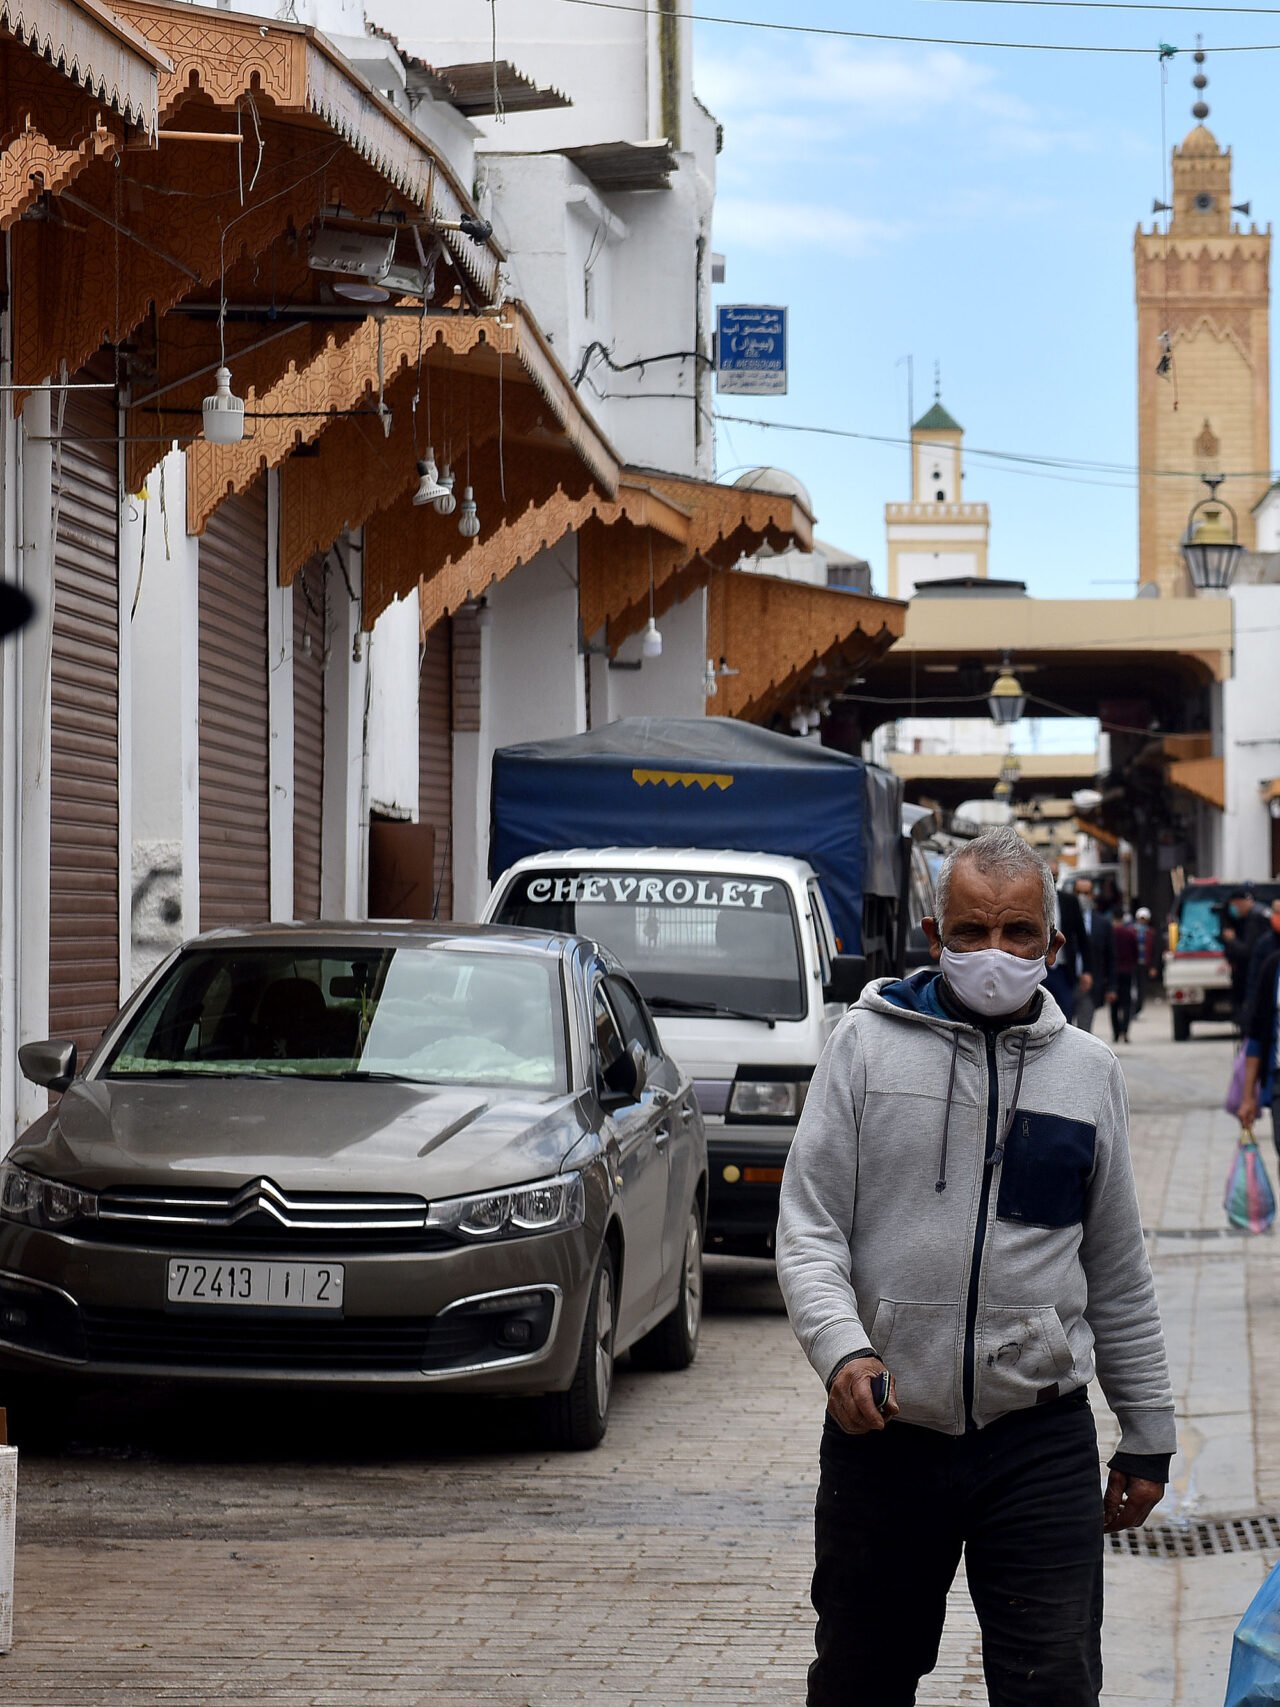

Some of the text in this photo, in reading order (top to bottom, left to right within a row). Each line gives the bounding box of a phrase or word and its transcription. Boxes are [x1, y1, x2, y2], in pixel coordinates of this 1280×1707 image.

[527, 877, 774, 908] CHEVROLET
[176, 1265, 252, 1298] 72413
[316, 1270, 331, 1301] 2
